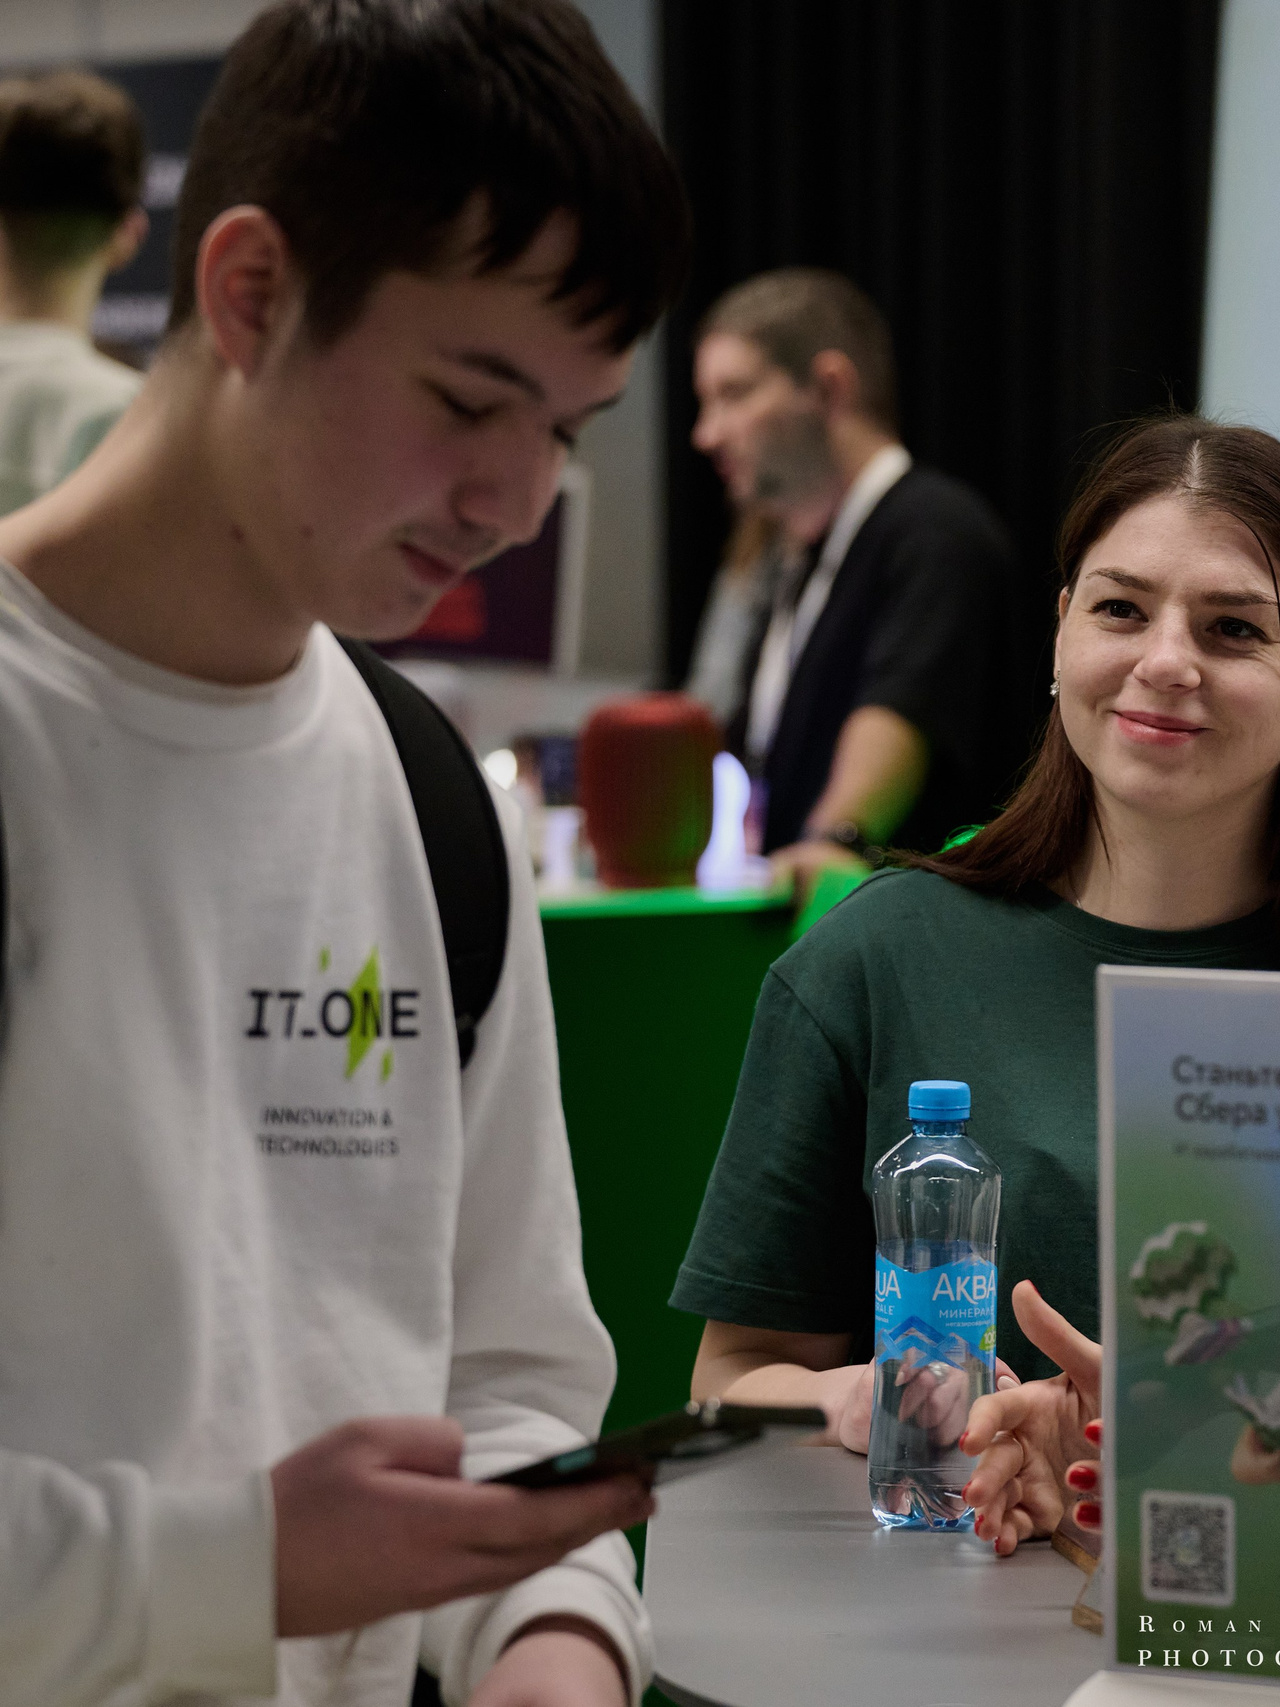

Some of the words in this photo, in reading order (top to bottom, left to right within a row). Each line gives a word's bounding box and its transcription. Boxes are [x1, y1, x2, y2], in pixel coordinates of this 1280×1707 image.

[262, 1105, 378, 1126] INNOVATION
[1174, 1090, 1267, 1129] Сбера
[257, 1133, 401, 1157] TECHNOLOGIES
[876, 1270, 901, 1302] UA
[932, 1269, 996, 1304] АКВА
